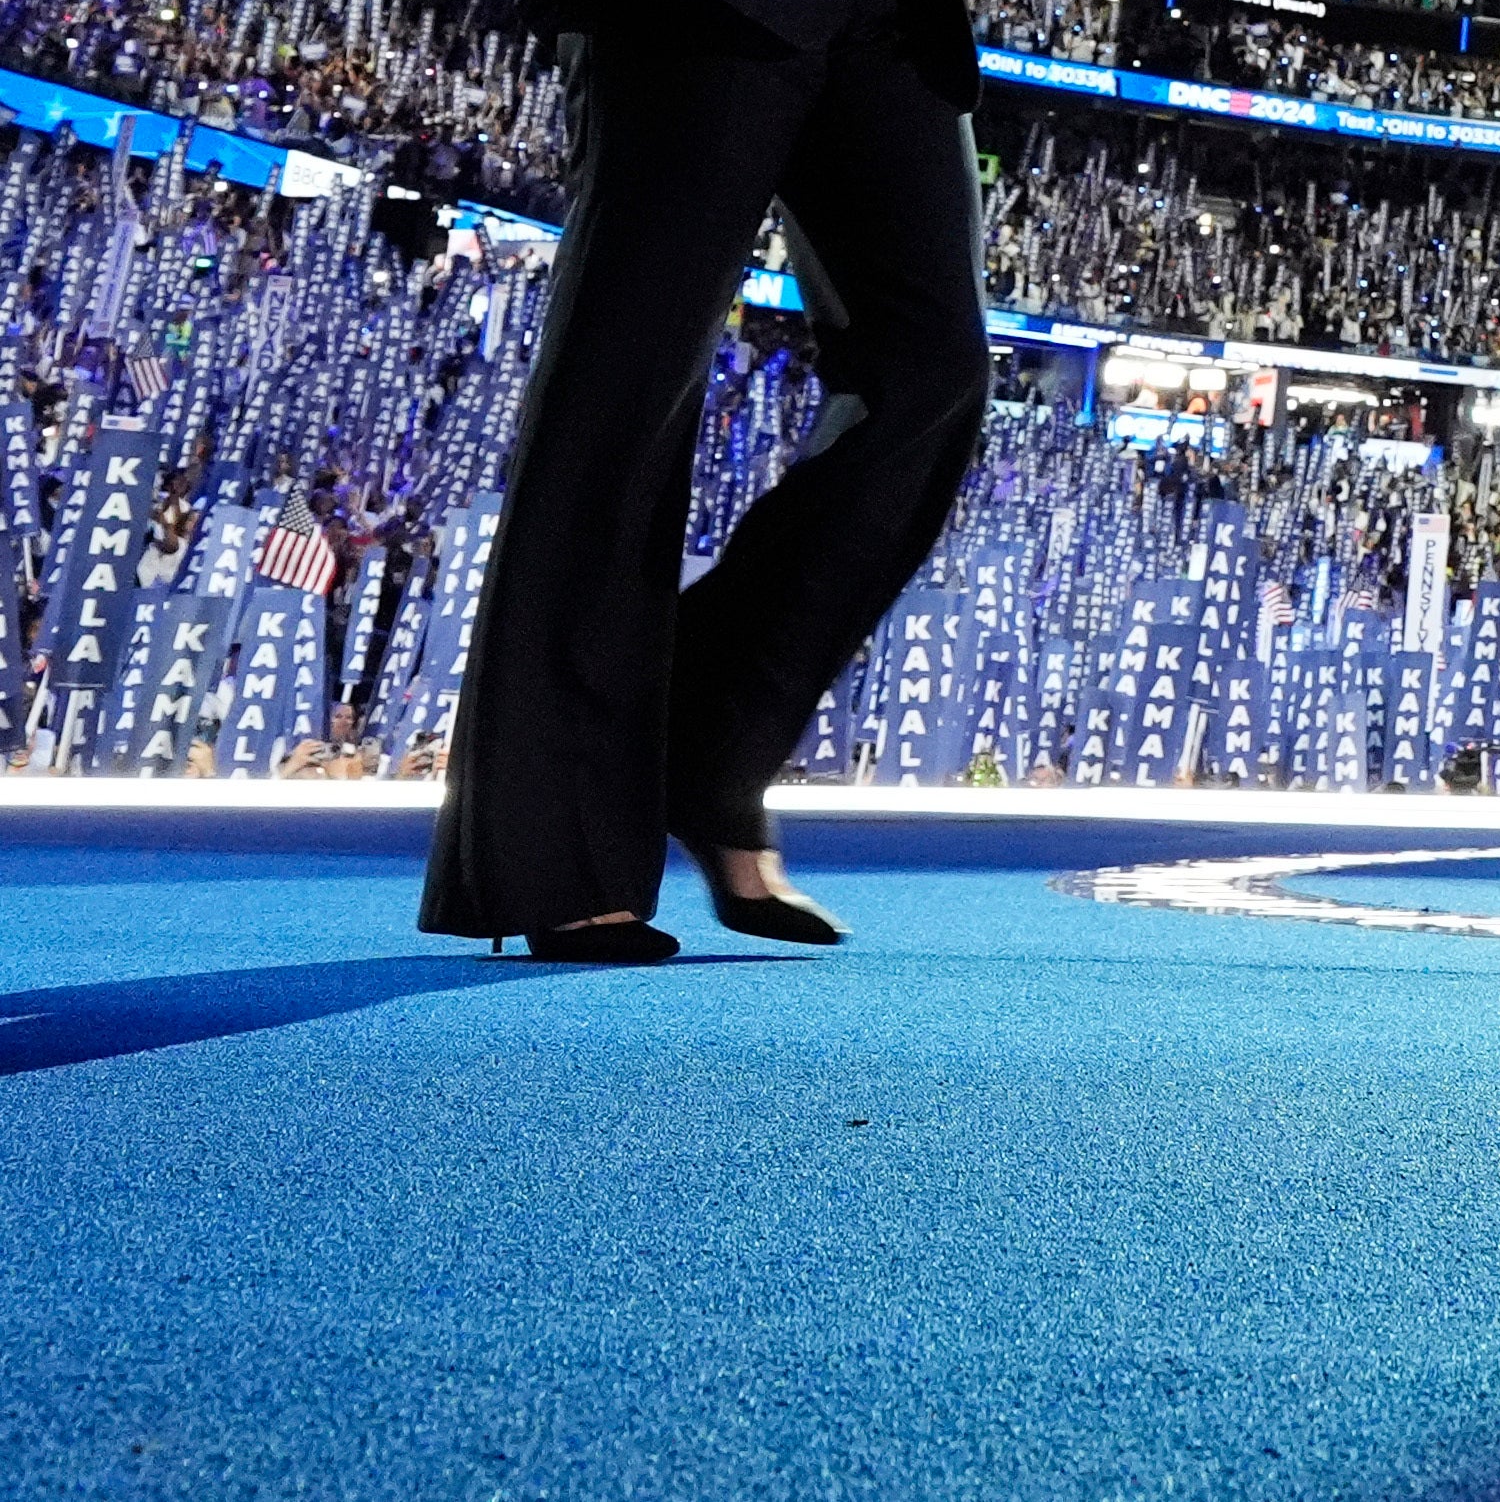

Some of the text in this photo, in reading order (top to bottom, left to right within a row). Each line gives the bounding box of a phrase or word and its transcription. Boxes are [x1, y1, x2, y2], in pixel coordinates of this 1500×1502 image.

[977, 52, 1023, 75] JOIN
[1025, 61, 1047, 79] to
[1168, 81, 1317, 125] DNC 2024
[5, 415, 33, 525] KAMALA
[67, 456, 142, 664] KAMALA
[347, 560, 386, 672] KAMALA
[1192, 523, 1235, 685] KAMALA
[1416, 539, 1436, 650] PENNSYLV
[899, 614, 932, 787] KAMALA
[1136, 645, 1182, 787] KAMAL
[1267, 635, 1288, 735] KAMALA
[1465, 598, 1500, 727] KAMALA
[1393, 668, 1421, 784] KAMAL
